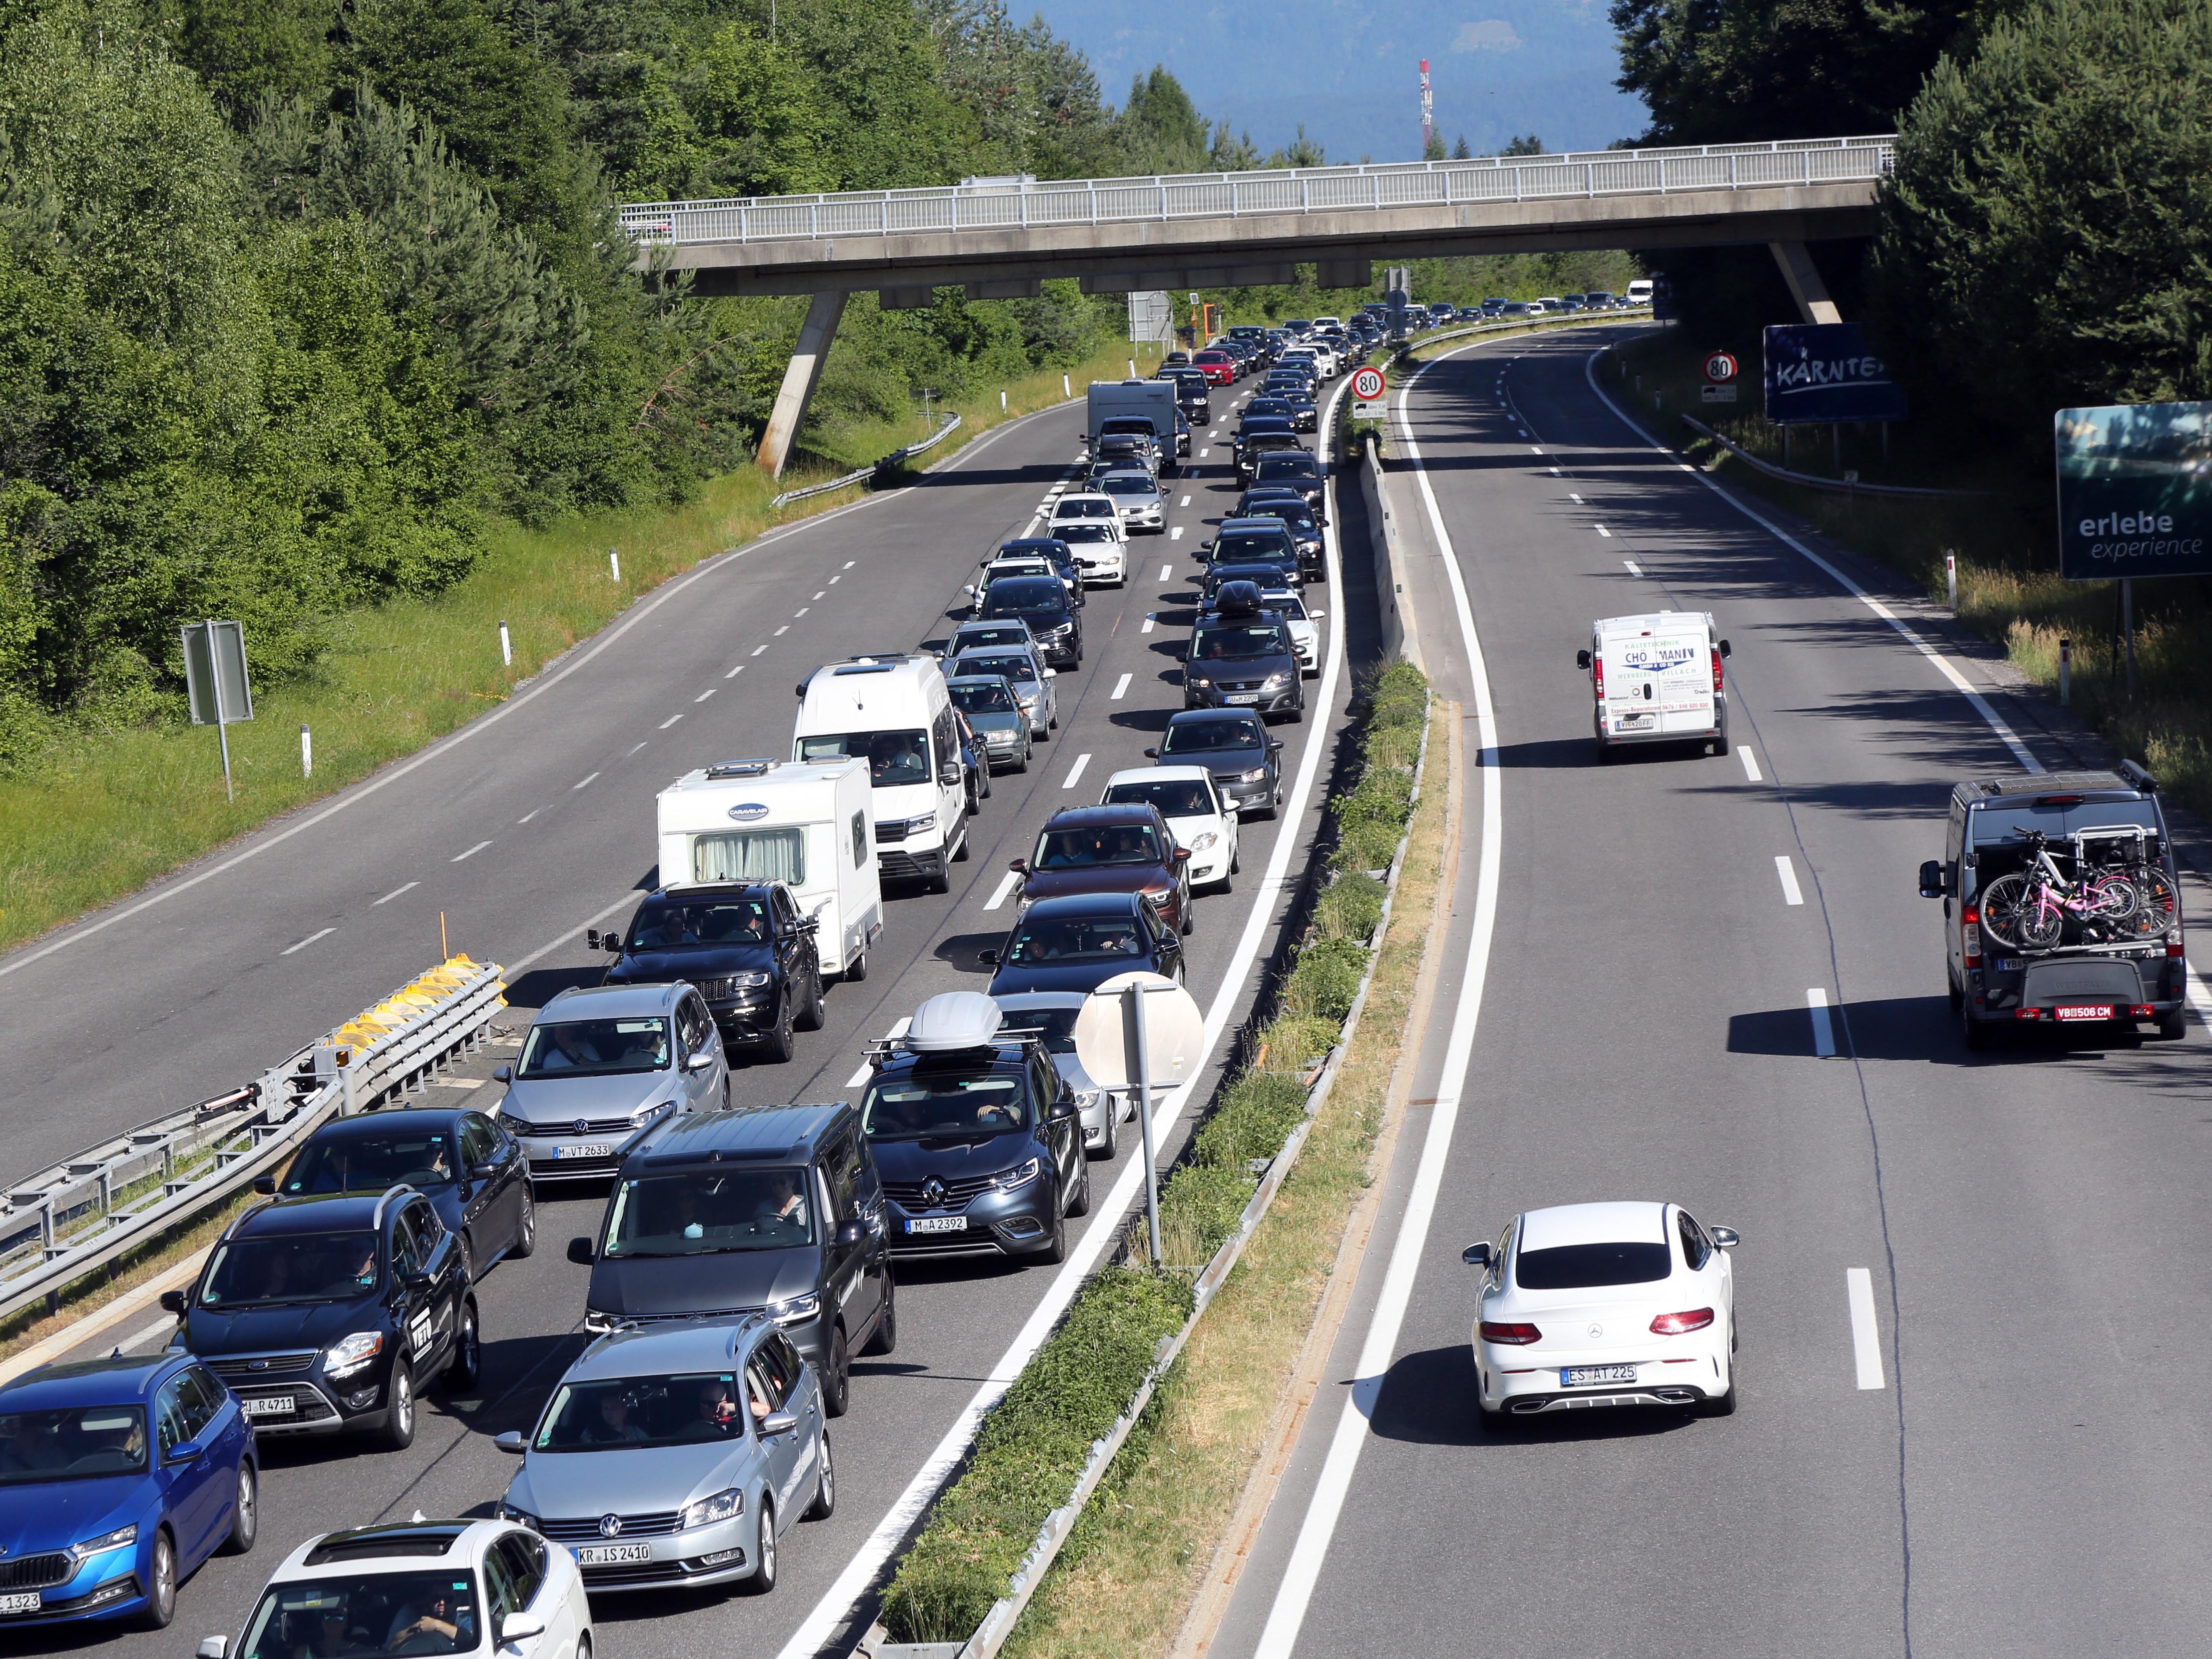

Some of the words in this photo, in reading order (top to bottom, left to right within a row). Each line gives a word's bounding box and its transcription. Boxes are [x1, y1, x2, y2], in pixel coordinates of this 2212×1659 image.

[1710, 360, 1728, 376] 80
[1360, 376, 1377, 392] 80
[2079, 511, 2173, 537] erlebe
[2091, 537, 2202, 563] experience
[1662, 668, 1696, 676] VILLACH
[729, 807, 768, 815] CARAVELAIR
[2058, 1008, 2071, 1017] VB
[2077, 1007, 2096, 1017] 506
[2097, 1007, 2111, 1017] CM
[559, 1148, 565, 1157] M
[571, 1147, 583, 1156] VT
[585, 1145, 608, 1156] 2633
[915, 1220, 923, 1230] M
[929, 1219, 936, 1230] A
[937, 1218, 963, 1229] 2392
[1569, 1369, 1585, 1381] ES
[1594, 1367, 1609, 1380] AT
[1612, 1366, 1635, 1378] 225
[259, 1400, 265, 1412] R
[268, 1398, 293, 1410] 4711
[579, 1549, 594, 1563] KR
[603, 1548, 617, 1561] IS
[620, 1546, 649, 1560] 2410
[7, 1594, 39, 1609] 1323
